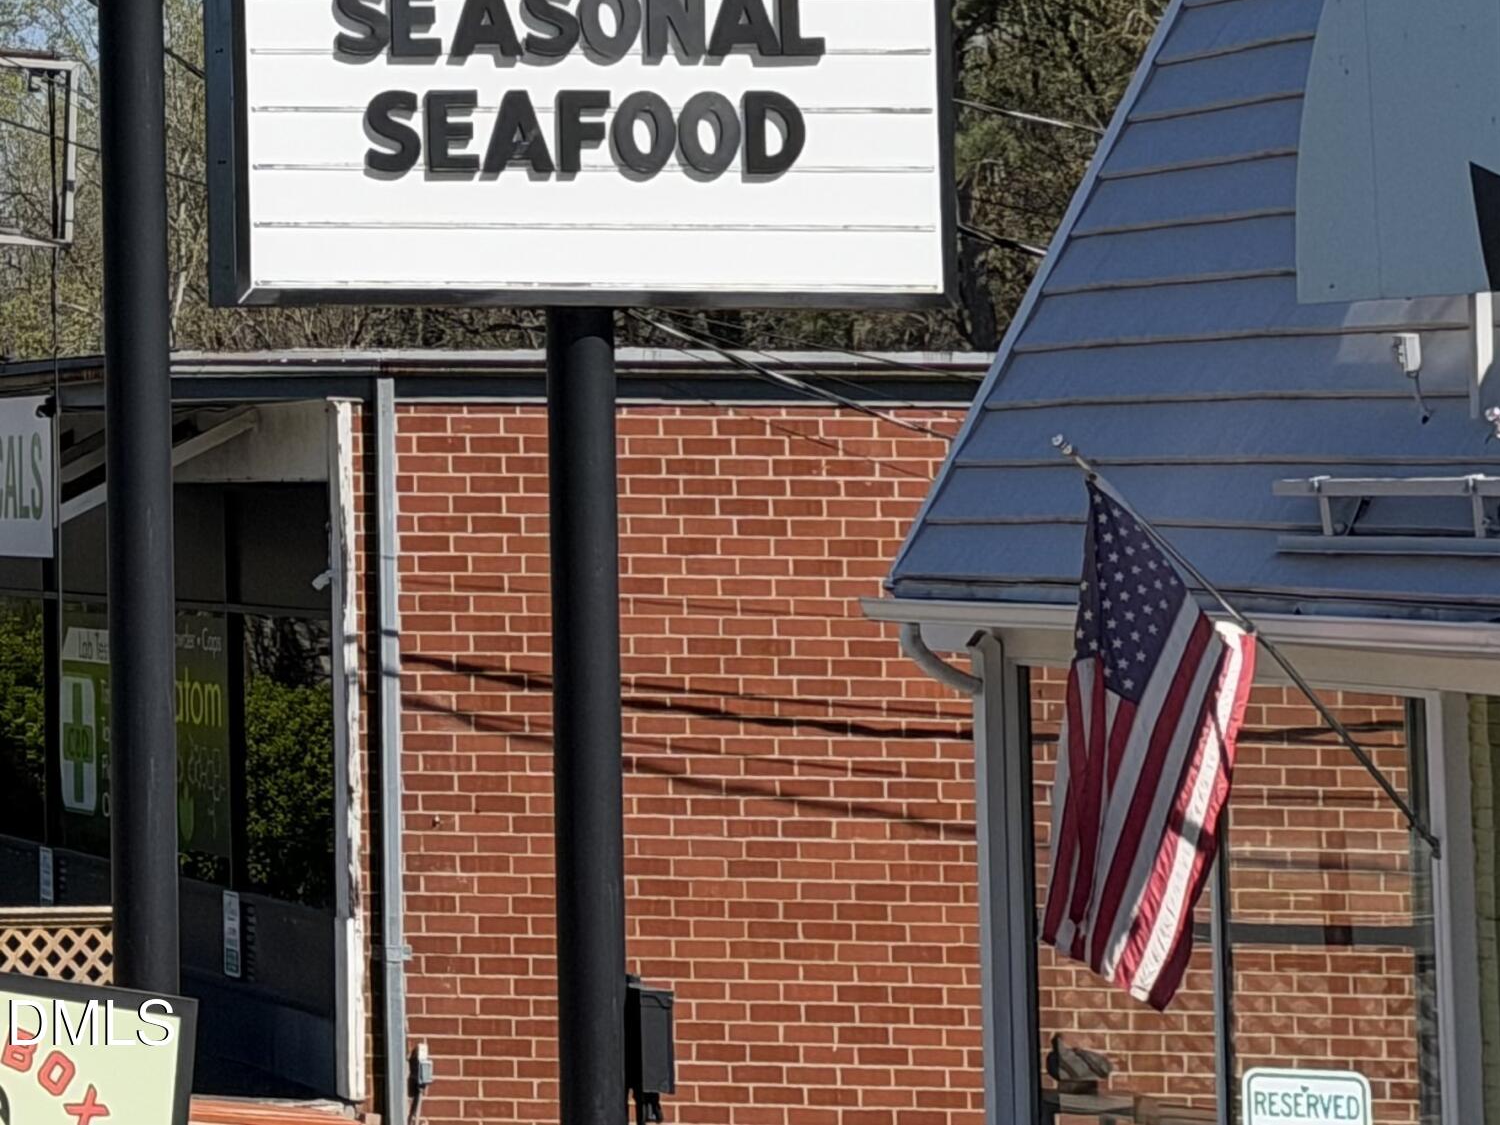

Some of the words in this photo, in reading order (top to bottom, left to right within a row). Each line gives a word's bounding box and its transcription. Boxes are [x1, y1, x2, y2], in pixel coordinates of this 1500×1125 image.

[363, 89, 806, 183] SEAFOOD
[175, 666, 223, 727] atom
[1, 1027, 110, 1125] BOX
[1253, 1090, 1361, 1120] RESERVED
